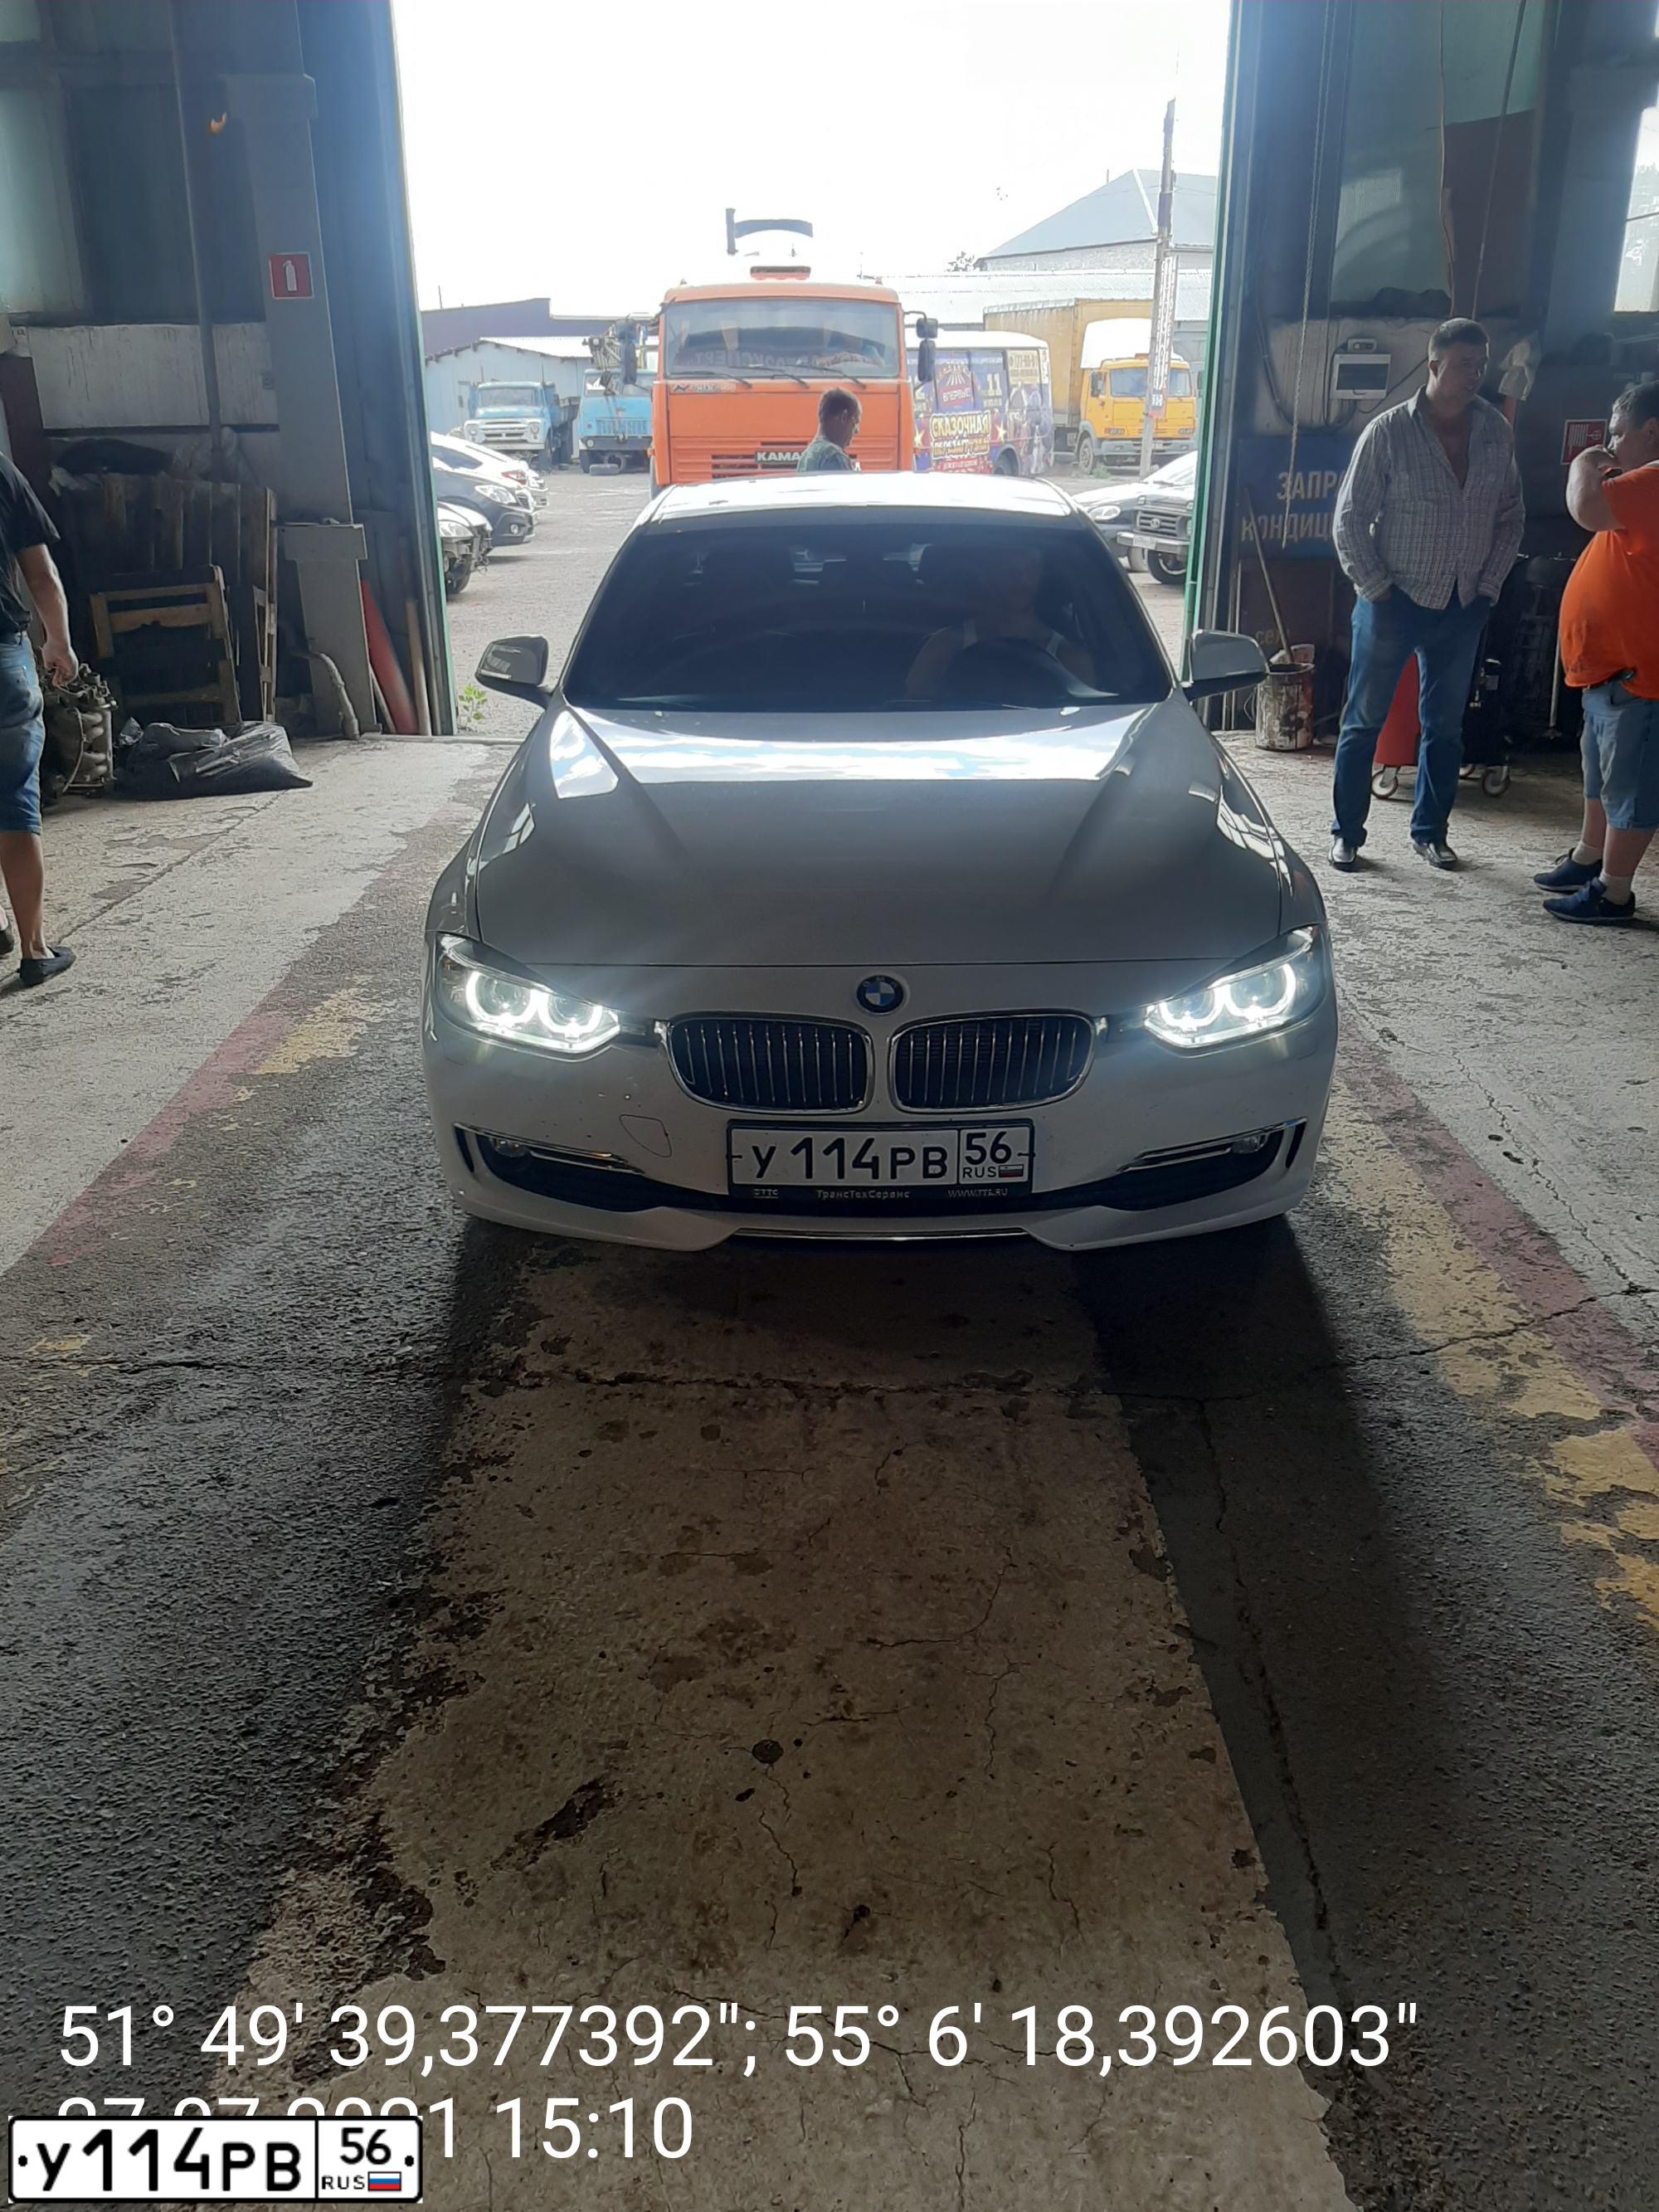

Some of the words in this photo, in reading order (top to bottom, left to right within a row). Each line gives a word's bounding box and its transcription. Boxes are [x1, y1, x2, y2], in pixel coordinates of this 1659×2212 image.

[932, 413, 990, 439] СКАЗОЧНАЯ
[1241, 513, 1332, 542] КОНДИЦ
[752, 1137, 947, 1180] У114РВ
[965, 1131, 1012, 1165] 56
[962, 1166, 996, 1178] RUS
[817, 1190, 911, 1200] ТрансТехСервис
